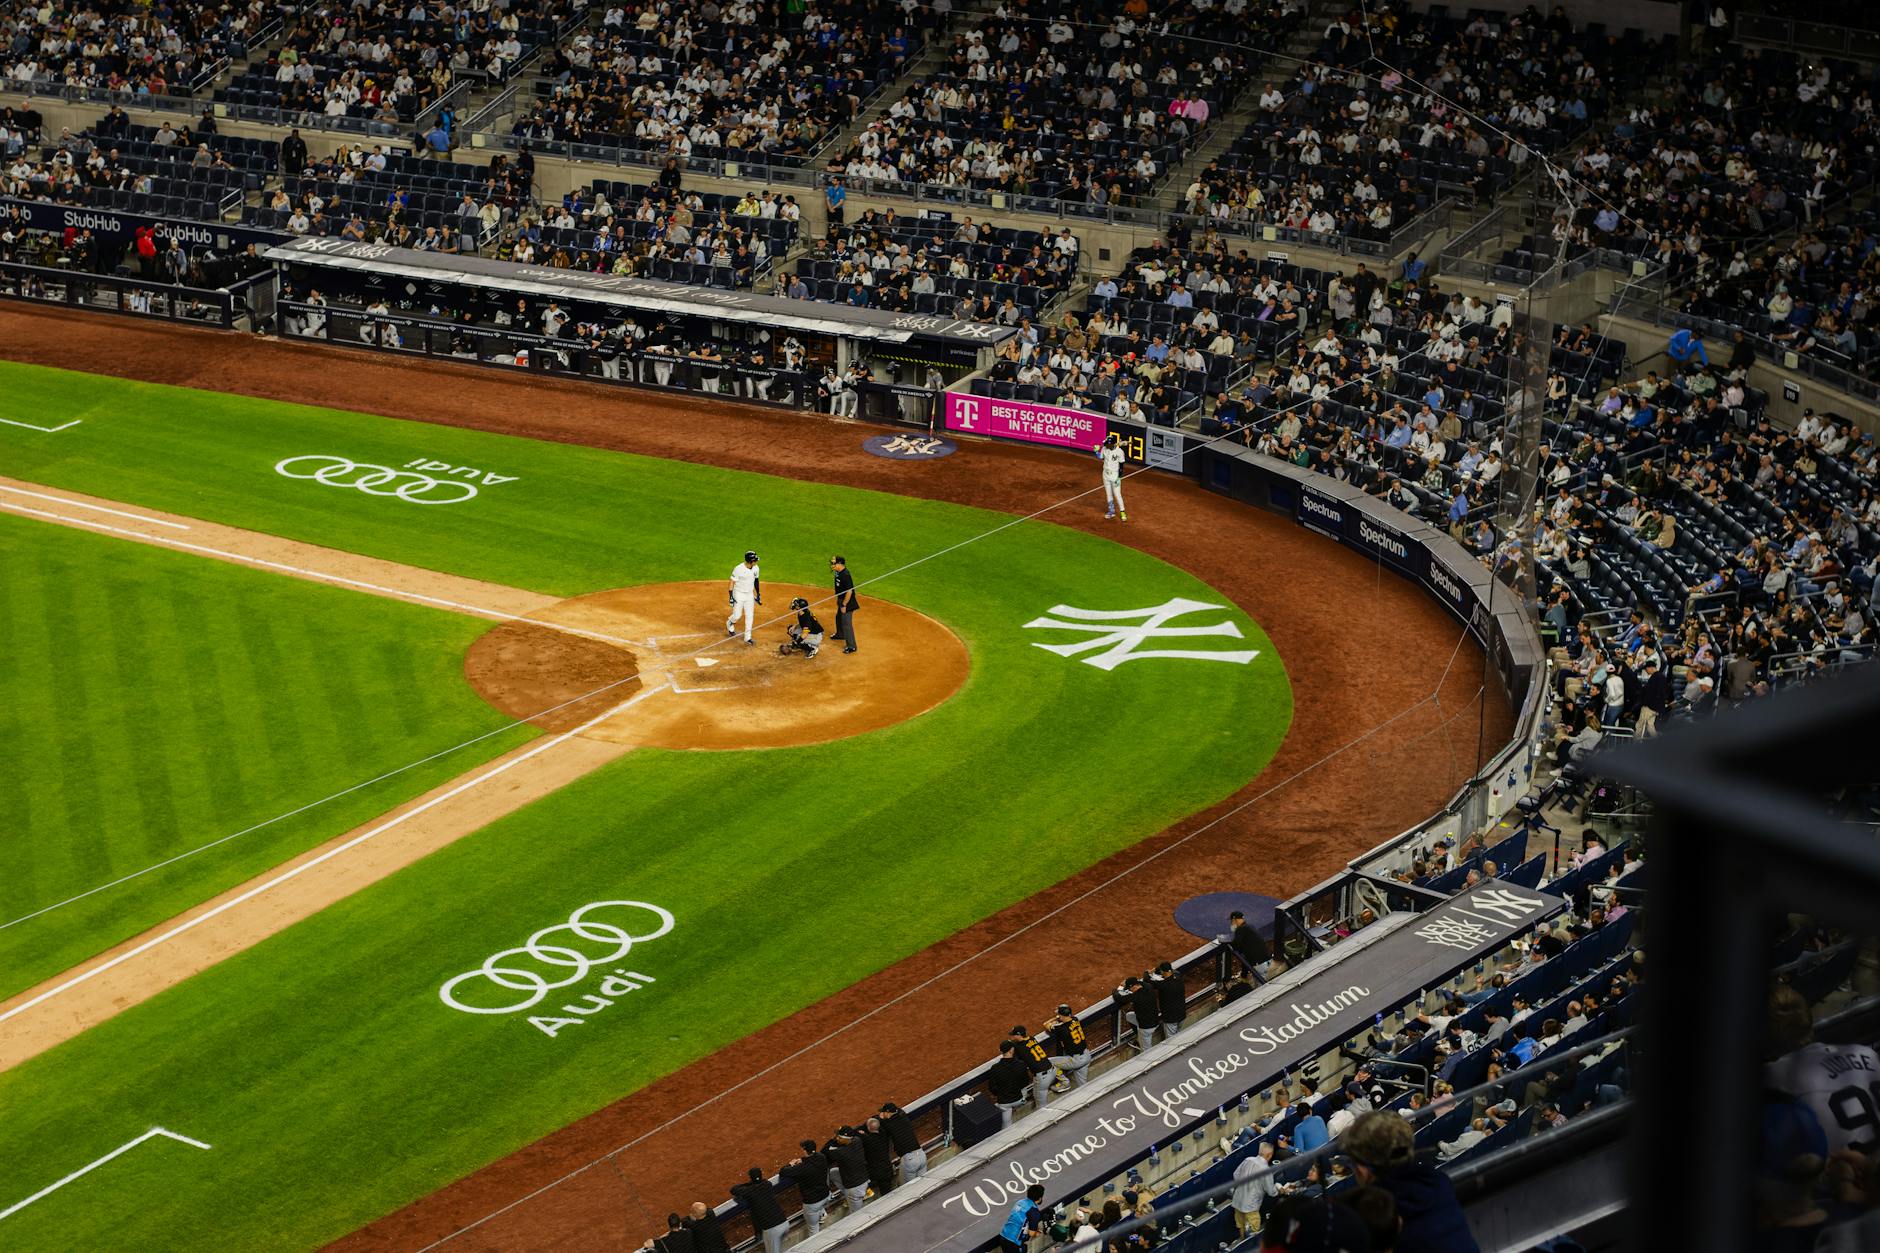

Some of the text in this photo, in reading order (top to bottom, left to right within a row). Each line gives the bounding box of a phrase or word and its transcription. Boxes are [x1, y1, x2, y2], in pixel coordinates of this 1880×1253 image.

[64, 211, 121, 232] StubHub
[154, 222, 212, 244] StubHub
[956, 398, 978, 429] T
[992, 406, 1092, 432] BEST 5G COVERAGE
[1009, 420, 1076, 440] IN THE GAME
[403, 458, 520, 485] Audi
[1302, 495, 1341, 522] Spectrum
[1360, 521, 1405, 558] Spectrum
[1430, 562, 1461, 602] Spectrum
[1414, 916, 1462, 940] NEW
[1427, 920, 1484, 946] YORK
[1453, 926, 1498, 950] LIFE
[527, 968, 656, 1038] Audi
[942, 985, 1370, 1217] Welcome to Yankee Stadium
